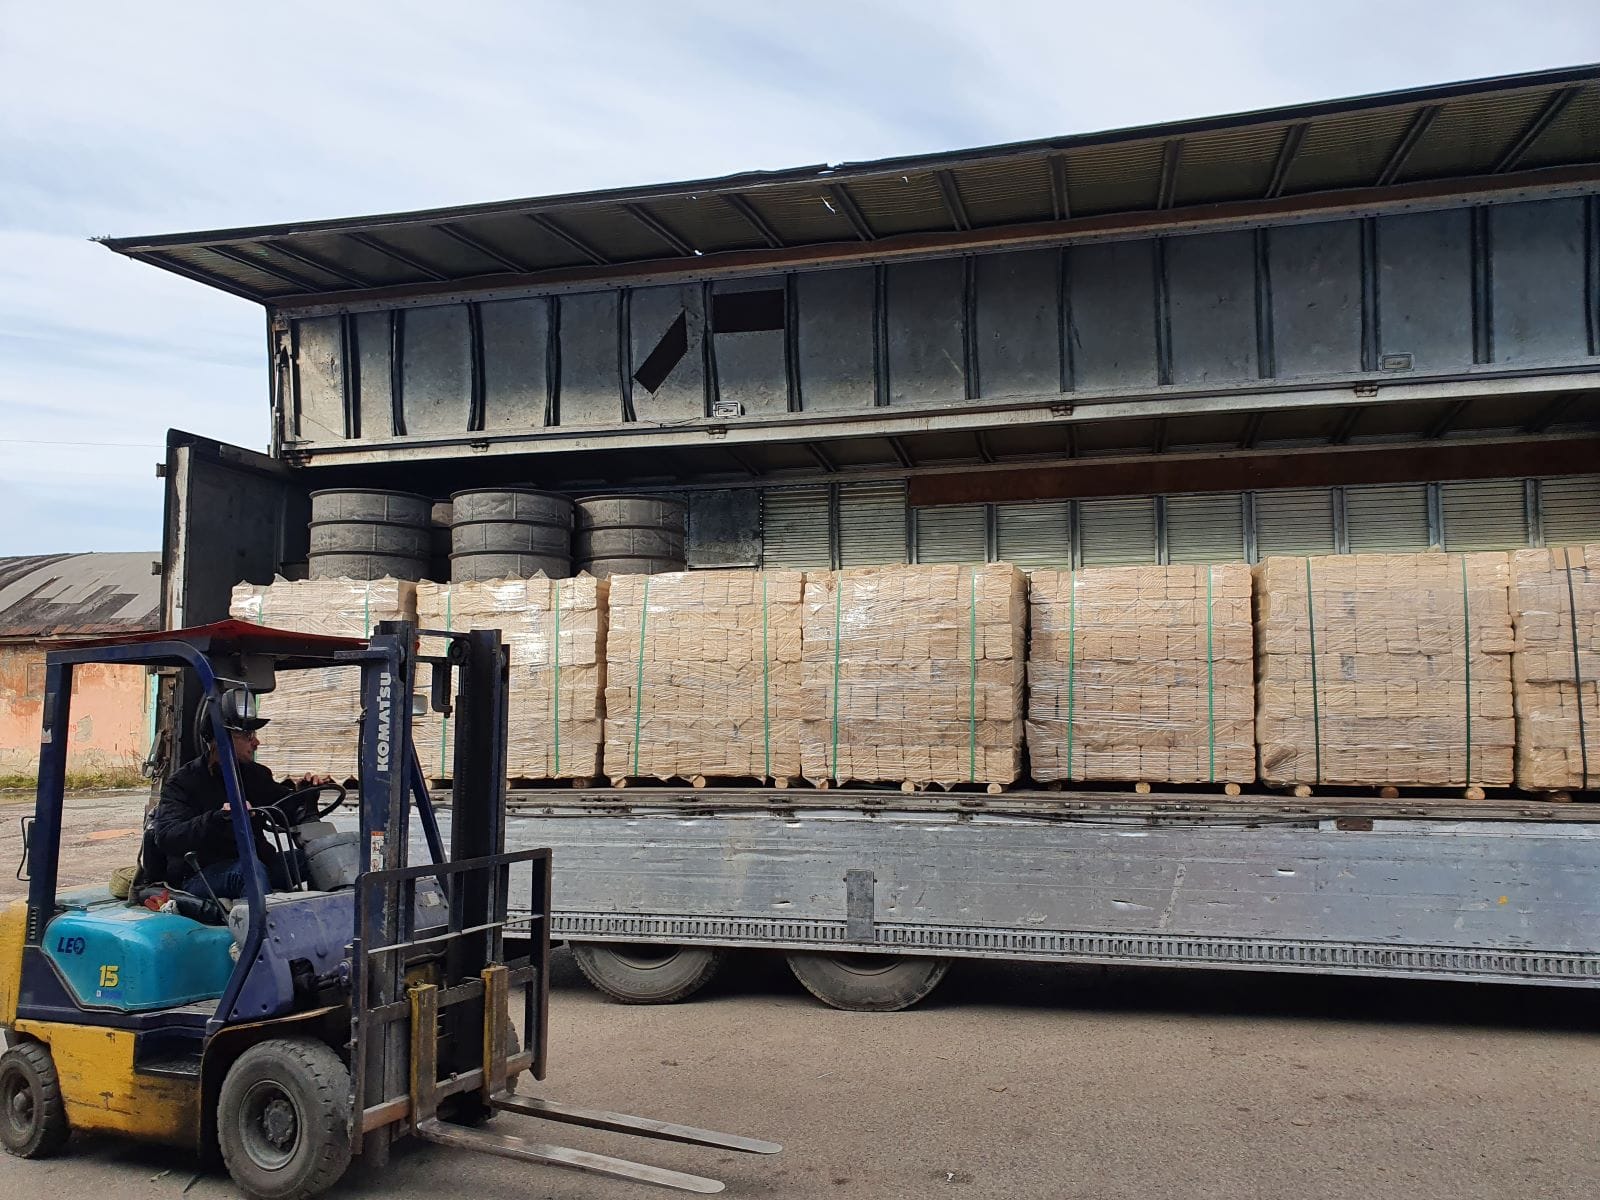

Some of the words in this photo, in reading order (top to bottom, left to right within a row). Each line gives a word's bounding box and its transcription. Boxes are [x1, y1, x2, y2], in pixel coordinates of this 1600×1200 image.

[376, 672, 392, 772] KOMATSU
[57, 936, 86, 955] LEO
[99, 965, 119, 987] 15
